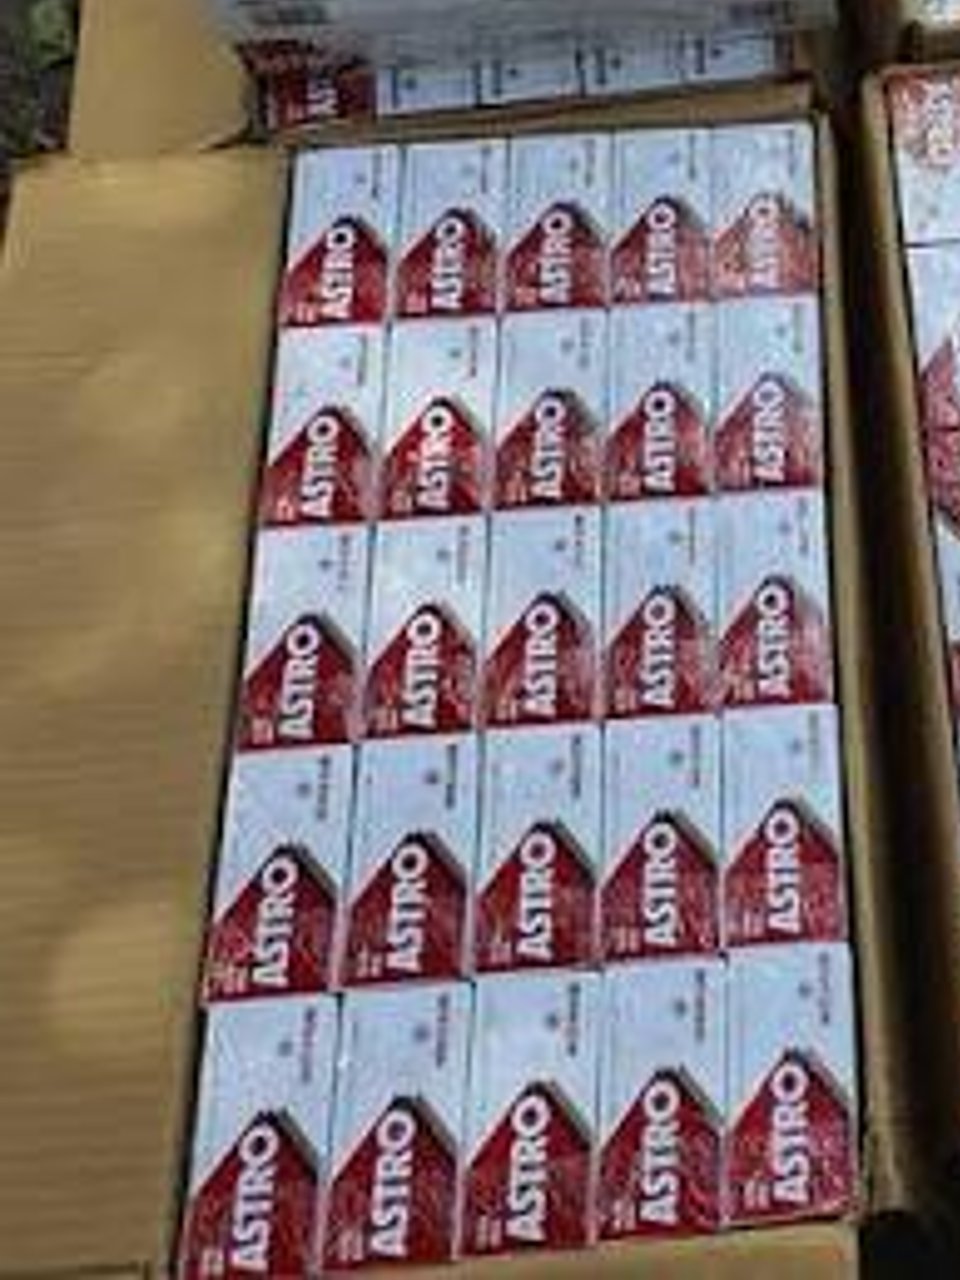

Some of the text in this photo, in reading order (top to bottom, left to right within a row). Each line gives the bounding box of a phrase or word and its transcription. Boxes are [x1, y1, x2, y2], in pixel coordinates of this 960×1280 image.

[320, 223, 356, 320] ASTRO
[430, 215, 466, 312] ASTRO
[538, 210, 573, 306] ASTRO
[645, 202, 679, 296] ASTRO
[301, 415, 340, 517] ASTRO
[418, 405, 455, 509] ASTRO
[531, 395, 567, 500] ASTRO
[644, 388, 678, 491] ASTRO
[752, 378, 786, 482] ASTRO
[280, 621, 322, 738] ASTRO
[405, 611, 443, 729] ASTRO
[525, 602, 560, 716] ASTRO
[644, 592, 678, 707] ASTRO
[756, 584, 790, 697] ASTRO
[252, 857, 297, 988] ASTRO
[386, 842, 430, 972] ASTRO
[518, 831, 556, 960] ASTRO
[643, 822, 679, 948] ASTRO
[768, 808, 802, 934] ASTRO
[371, 1111, 417, 1257] ASTRO
[507, 1095, 549, 1243] ASTRO
[639, 1078, 681, 1225] ASTRO
[773, 1062, 810, 1203] ASTRO
[232, 1123, 278, 1271] ASTRO
